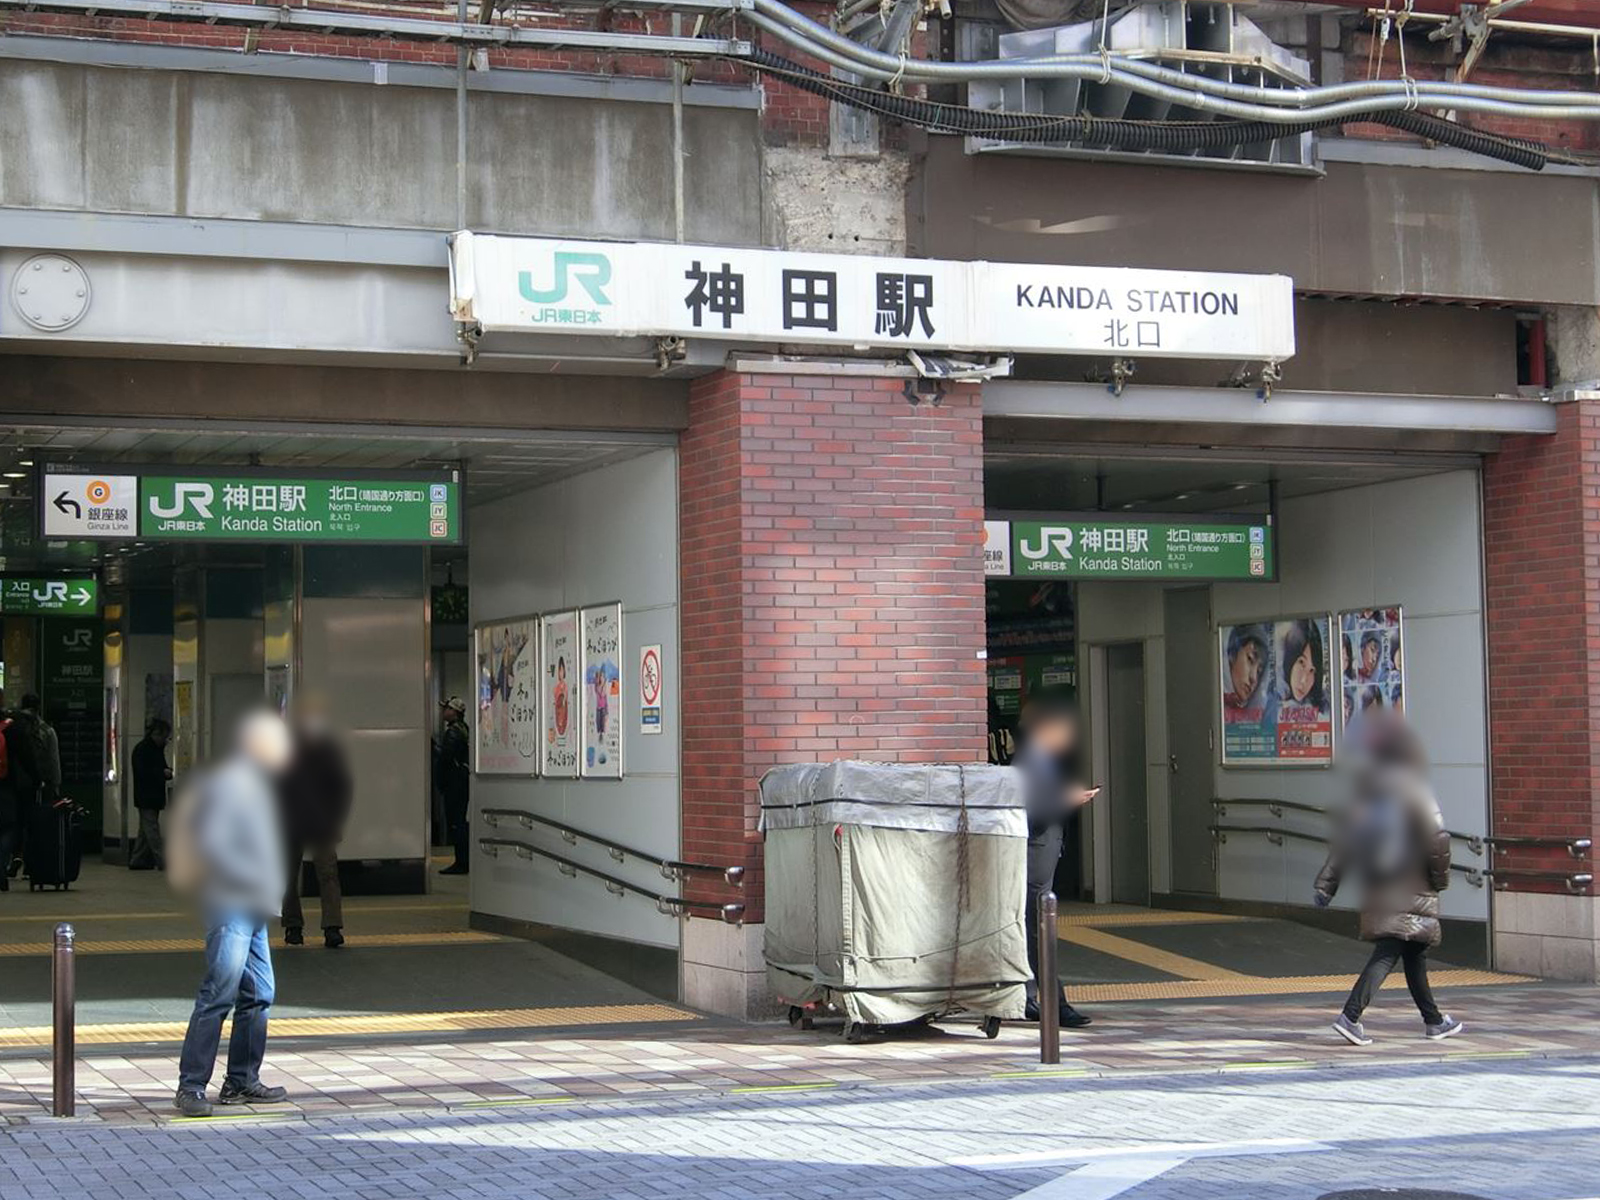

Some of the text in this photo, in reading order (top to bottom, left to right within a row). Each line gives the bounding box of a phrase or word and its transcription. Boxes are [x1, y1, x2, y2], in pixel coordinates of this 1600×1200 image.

[518, 251, 613, 305] JR
[684, 260, 936, 340] 神田駅
[1017, 284, 1239, 315] KANDA STATION
[531, 308, 602, 324] JR東日本
[1104, 318, 1161, 348] 北口
[94, 487, 104, 497] G
[222, 484, 307, 512] 神田駅
[150, 482, 214, 519] JR
[329, 503, 392, 513] North Entrance
[88, 508, 128, 521] 銀座線
[87, 522, 129, 531] Ginza Line
[158, 520, 206, 531] JR東日本
[221, 516, 322, 532] Kanda Station
[1020, 527, 1073, 559] JR
[1080, 528, 1149, 553] 神田駅
[1166, 544, 1219, 553] North Entrance
[1028, 562, 1067, 571] JR東日本
[1079, 557, 1117, 571] Kanda
[1121, 557, 1162, 571] Station
[12, 582, 30, 591] 入口
[33, 582, 68, 601] JR
[63, 629, 92, 646] JR
